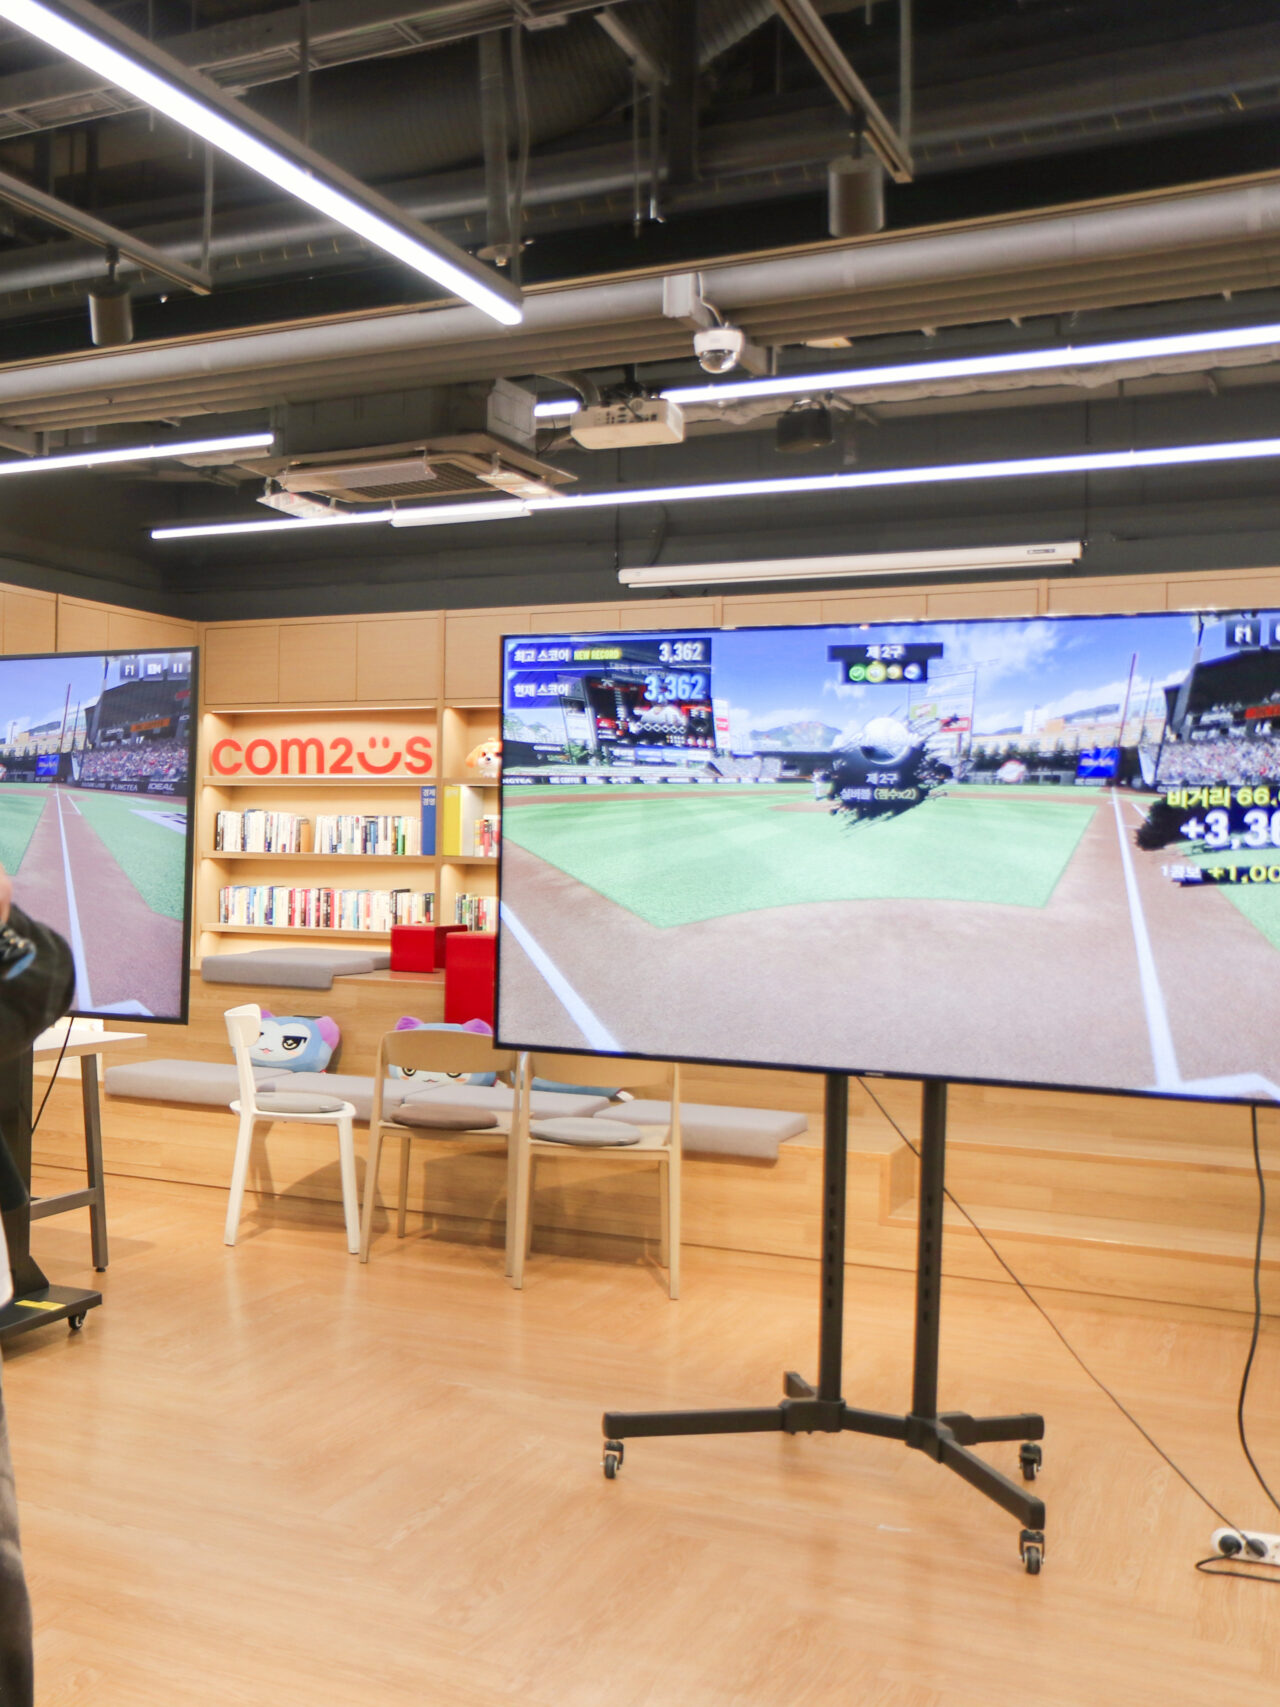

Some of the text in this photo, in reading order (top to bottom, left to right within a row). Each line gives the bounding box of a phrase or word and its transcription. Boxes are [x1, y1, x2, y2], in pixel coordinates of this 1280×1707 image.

[514, 649, 536, 663] 최고
[537, 648, 570, 663] 스코어
[658, 642, 703, 663] 3,362
[514, 684, 536, 697] 현재
[537, 683, 570, 697] 스코어
[643, 673, 705, 703] 3,362
[1166, 785, 1280, 809] 비거리 66.
